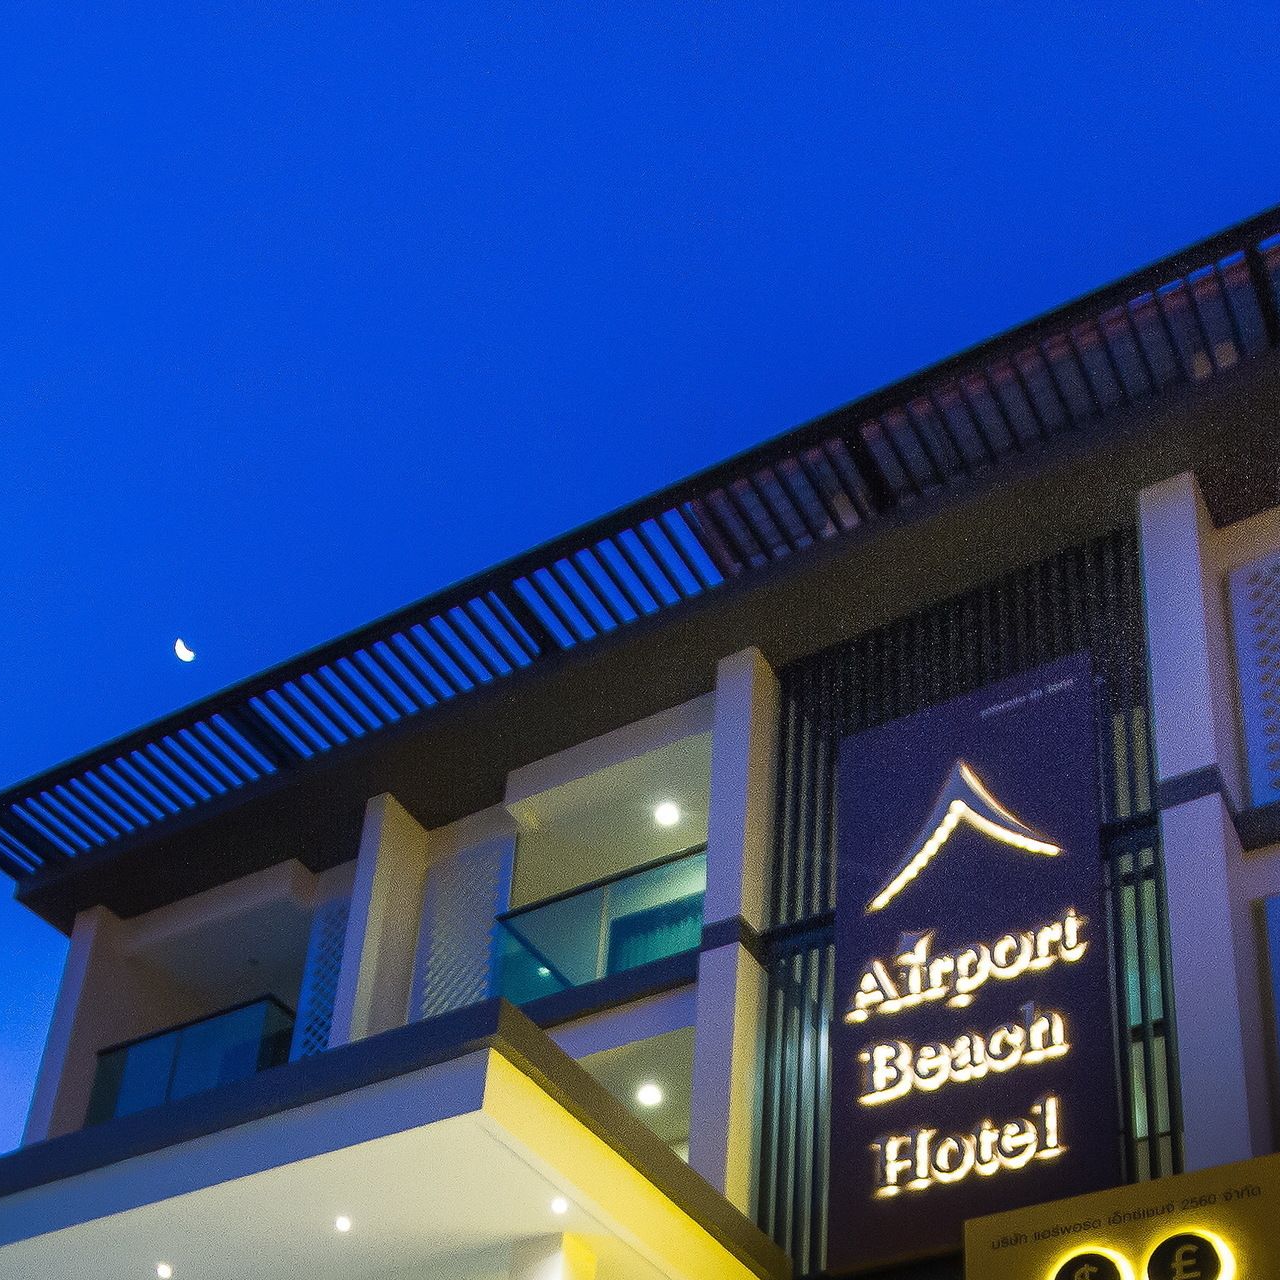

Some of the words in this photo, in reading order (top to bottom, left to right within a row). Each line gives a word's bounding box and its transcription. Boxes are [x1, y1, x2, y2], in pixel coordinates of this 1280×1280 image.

[845, 908, 1088, 1024] Airport
[858, 1000, 1072, 1106] Beach
[872, 1095, 1069, 1199] Hotel
[1180, 1192, 1218, 1210] 2560
